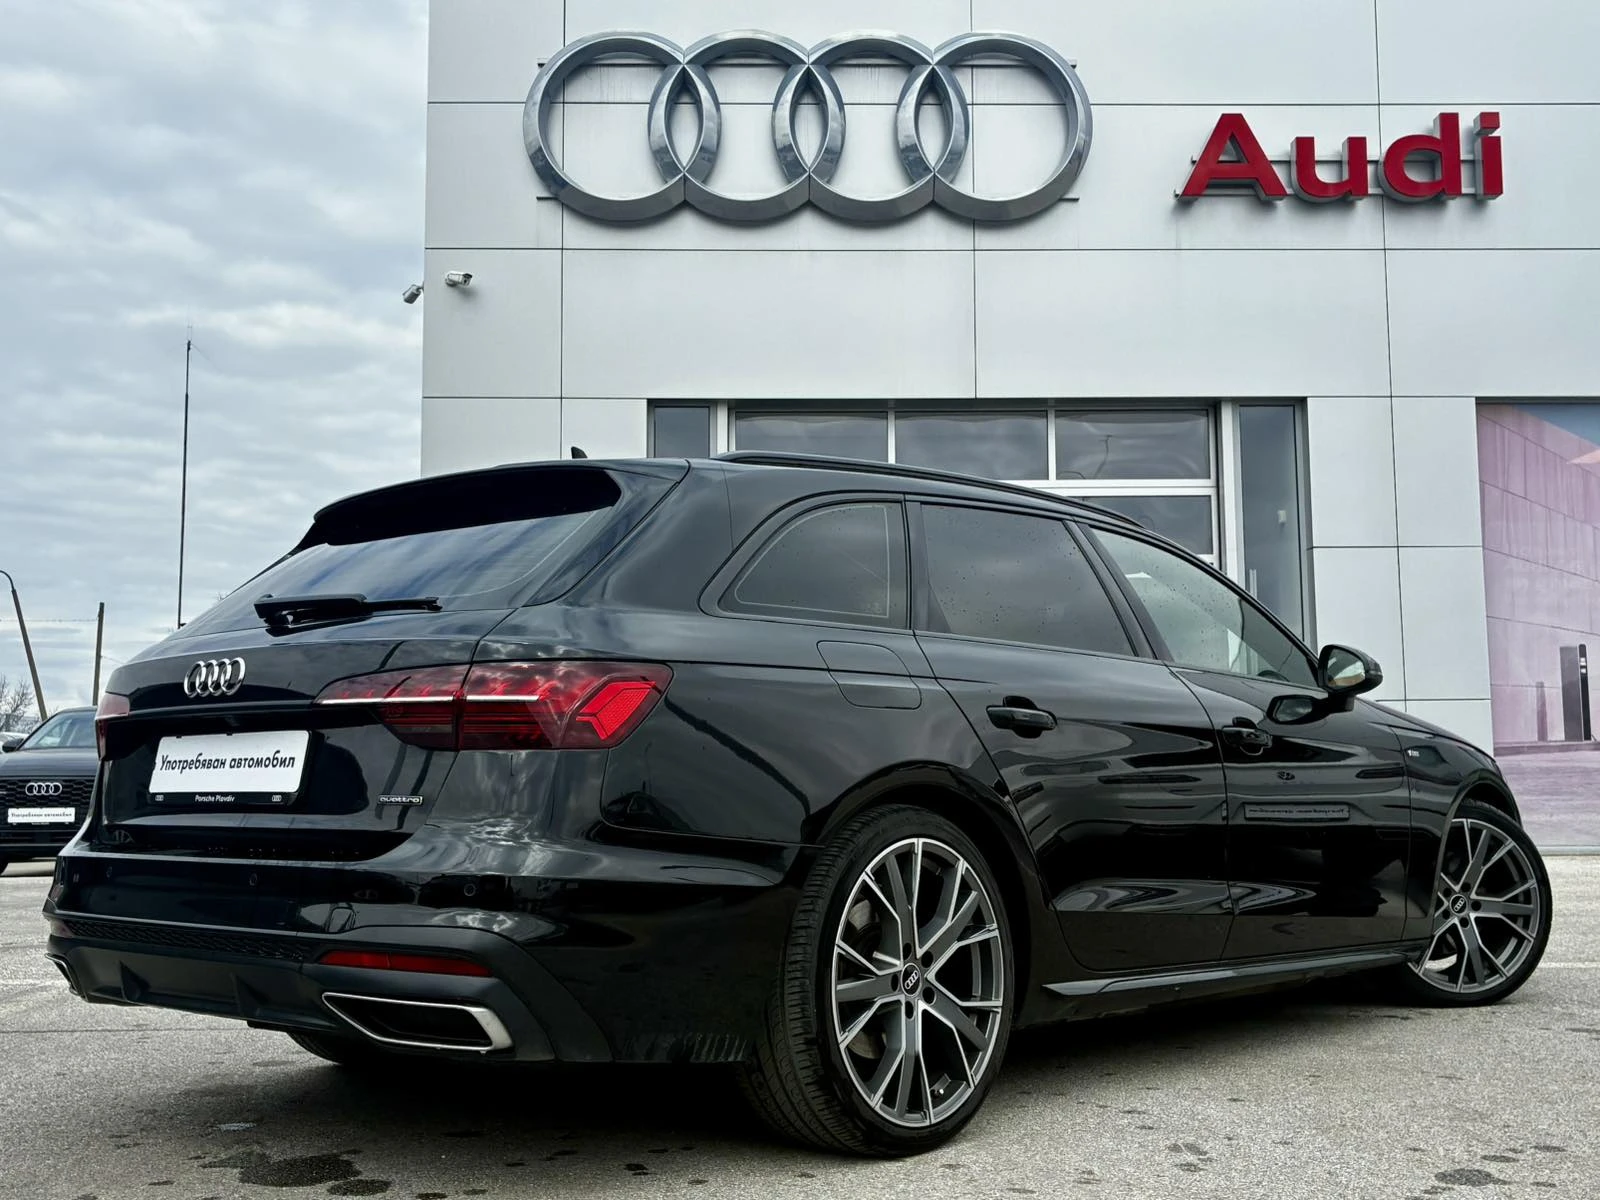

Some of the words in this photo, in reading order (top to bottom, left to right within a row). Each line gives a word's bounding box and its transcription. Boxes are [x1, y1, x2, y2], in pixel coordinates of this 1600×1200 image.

[1178, 111, 1503, 199] Audi
[160, 753, 226, 774] Употребяван
[229, 750, 295, 768] автомобил
[194, 794, 215, 802] Porsche
